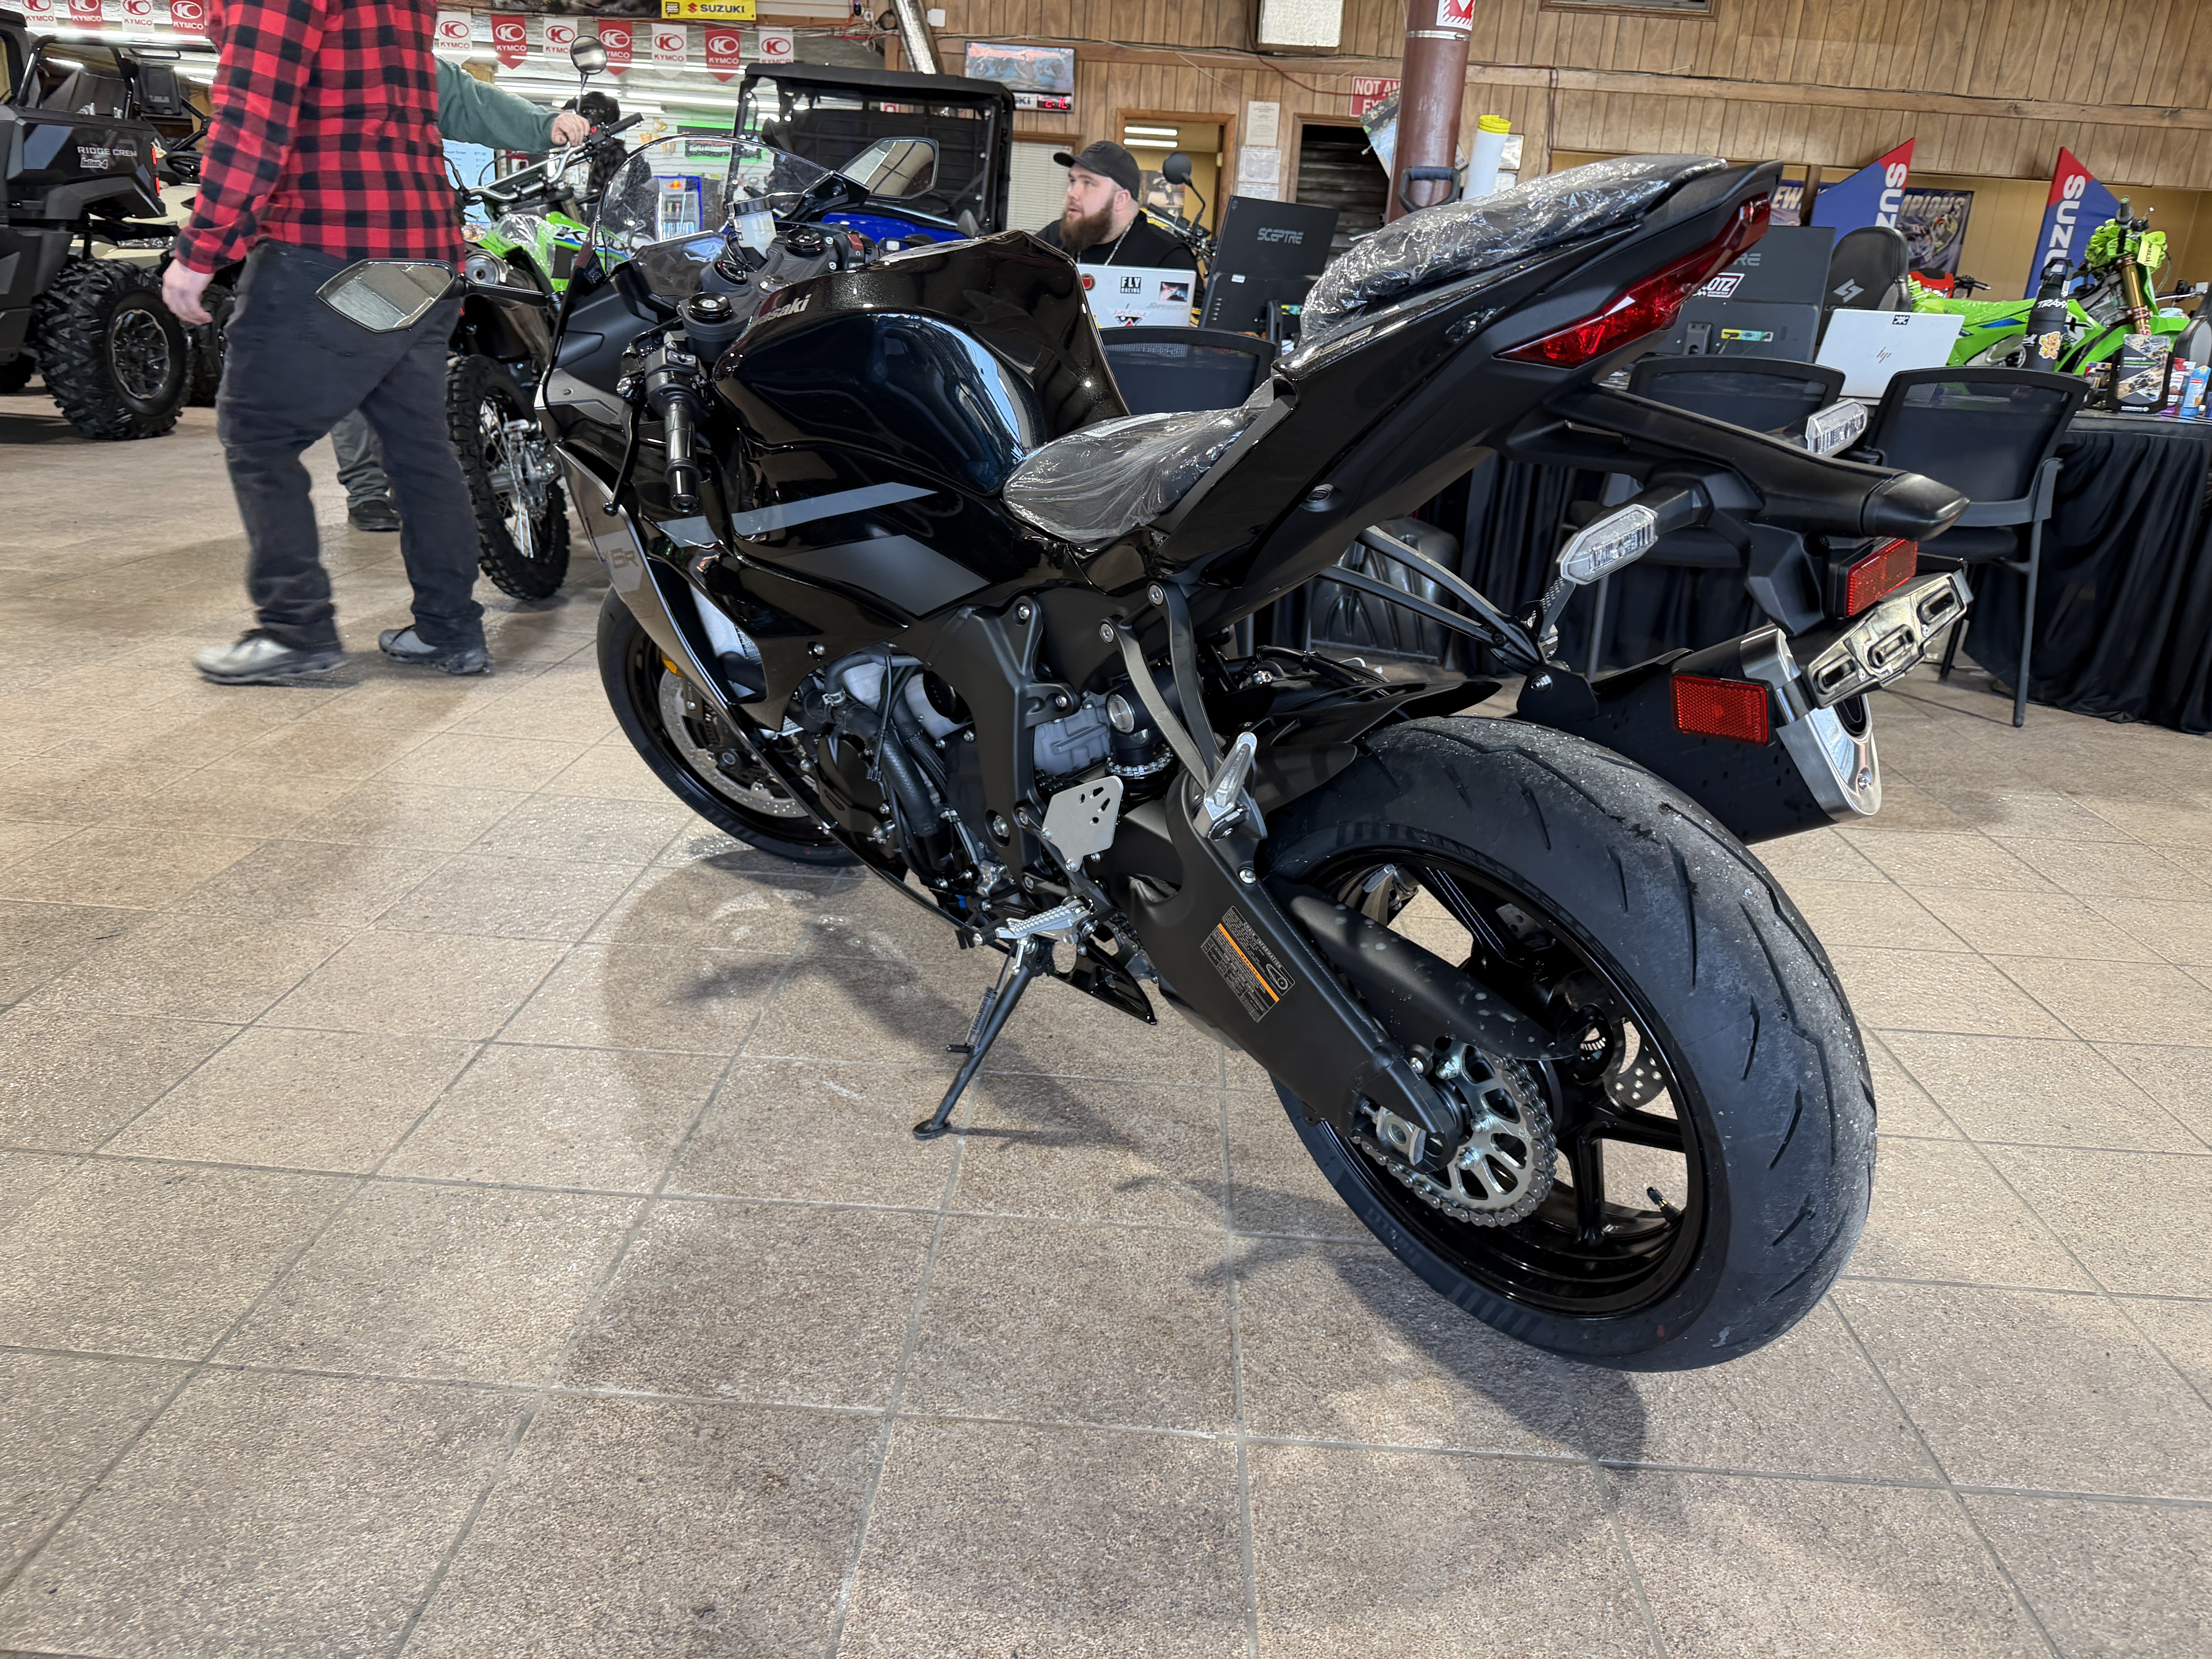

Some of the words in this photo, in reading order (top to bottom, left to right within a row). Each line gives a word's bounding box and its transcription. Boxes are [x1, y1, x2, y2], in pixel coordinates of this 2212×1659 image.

[700, 4, 745, 13] SUZUKI
[124, 18, 153, 26] KYMCO
[173, 21, 204, 30] KYMCO
[654, 53, 685, 62] KYMCO
[1355, 79, 1382, 95] NOT
[77, 146, 111, 155] RIDGE
[1875, 163, 1907, 228] SUZ
[2044, 174, 2086, 273] SUZU
[1257, 227, 1304, 244] SCEPTRE
[1121, 277, 1141, 287] FLY
[1706, 277, 1737, 292] OTZ
[1243, 922, 1256, 938] CHAIN
[1256, 937, 1282, 968] INFORMATION
